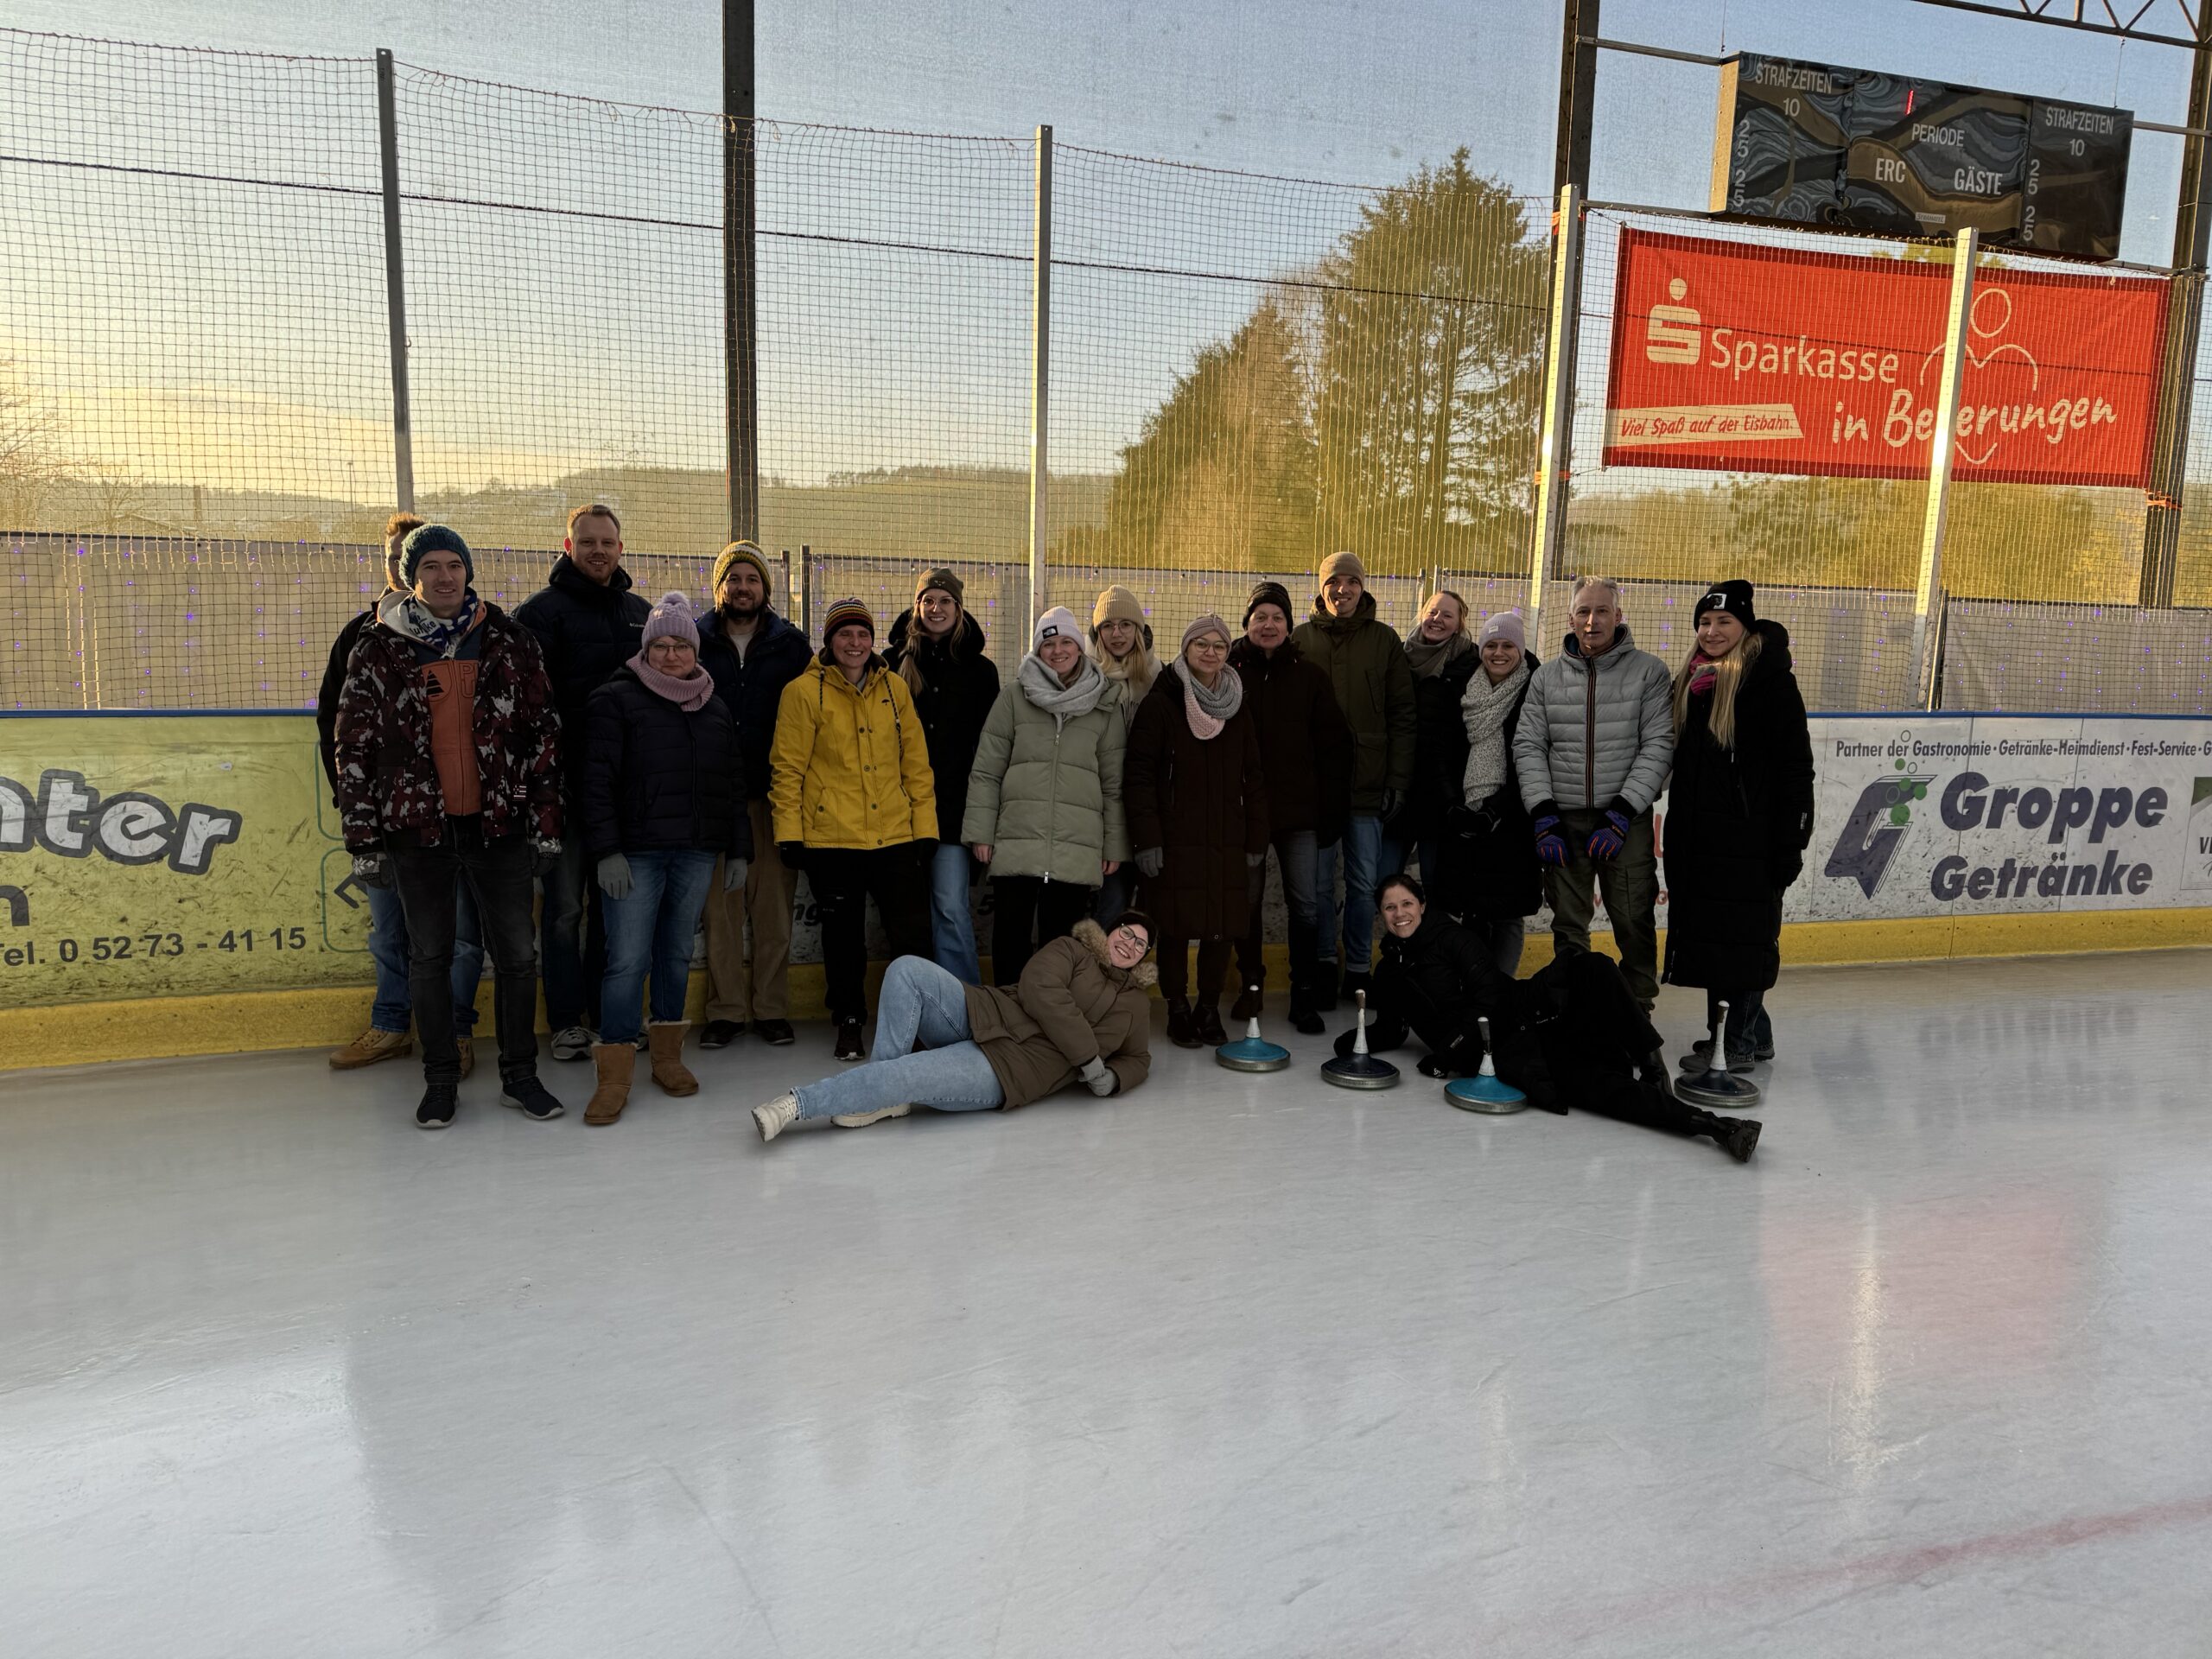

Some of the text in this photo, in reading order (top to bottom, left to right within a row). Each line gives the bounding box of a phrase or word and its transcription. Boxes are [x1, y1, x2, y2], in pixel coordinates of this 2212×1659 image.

[1755, 62, 1833, 94] STRAFZEITEN
[1783, 98, 1801, 117] 10
[1739, 119, 1751, 138] 2
[2045, 106, 2114, 135] STRAFZEITEN
[1911, 123, 1965, 148] PERIODE
[1737, 139, 1750, 157] 5
[2069, 138, 2085, 156] 10
[1734, 168, 1746, 188] 2
[1875, 157, 1906, 183] ERC
[2030, 159, 2040, 177] 2
[1955, 166, 2003, 195] GÄSTE
[2028, 177, 2039, 195] 5
[1732, 188, 1745, 207] 5
[2024, 206, 2036, 223] 2
[2023, 224, 2034, 242] 5
[1710, 327, 1899, 384] Sparkasse
[1621, 414, 1794, 438] Viel Spaß auf der Eisbahn.
[1832, 388, 2117, 448] in Beerungen
[1836, 740, 1883, 758] Partner
[1887, 739, 1909, 757] der
[1913, 740, 1991, 757] Gastronomie
[1999, 739, 2125, 756] Getränke-Heimdienst
[2131, 739, 2196, 756] Fest-Service
[1940, 772, 2168, 844] Groppe
[1930, 850, 2153, 902] Getränke
[0, 940, 46, 967] el.
[59, 938, 79, 963] 0
[92, 935, 132, 961] 52
[143, 932, 185, 957] 73
[218, 929, 253, 953] 41
[270, 926, 307, 950] 15
